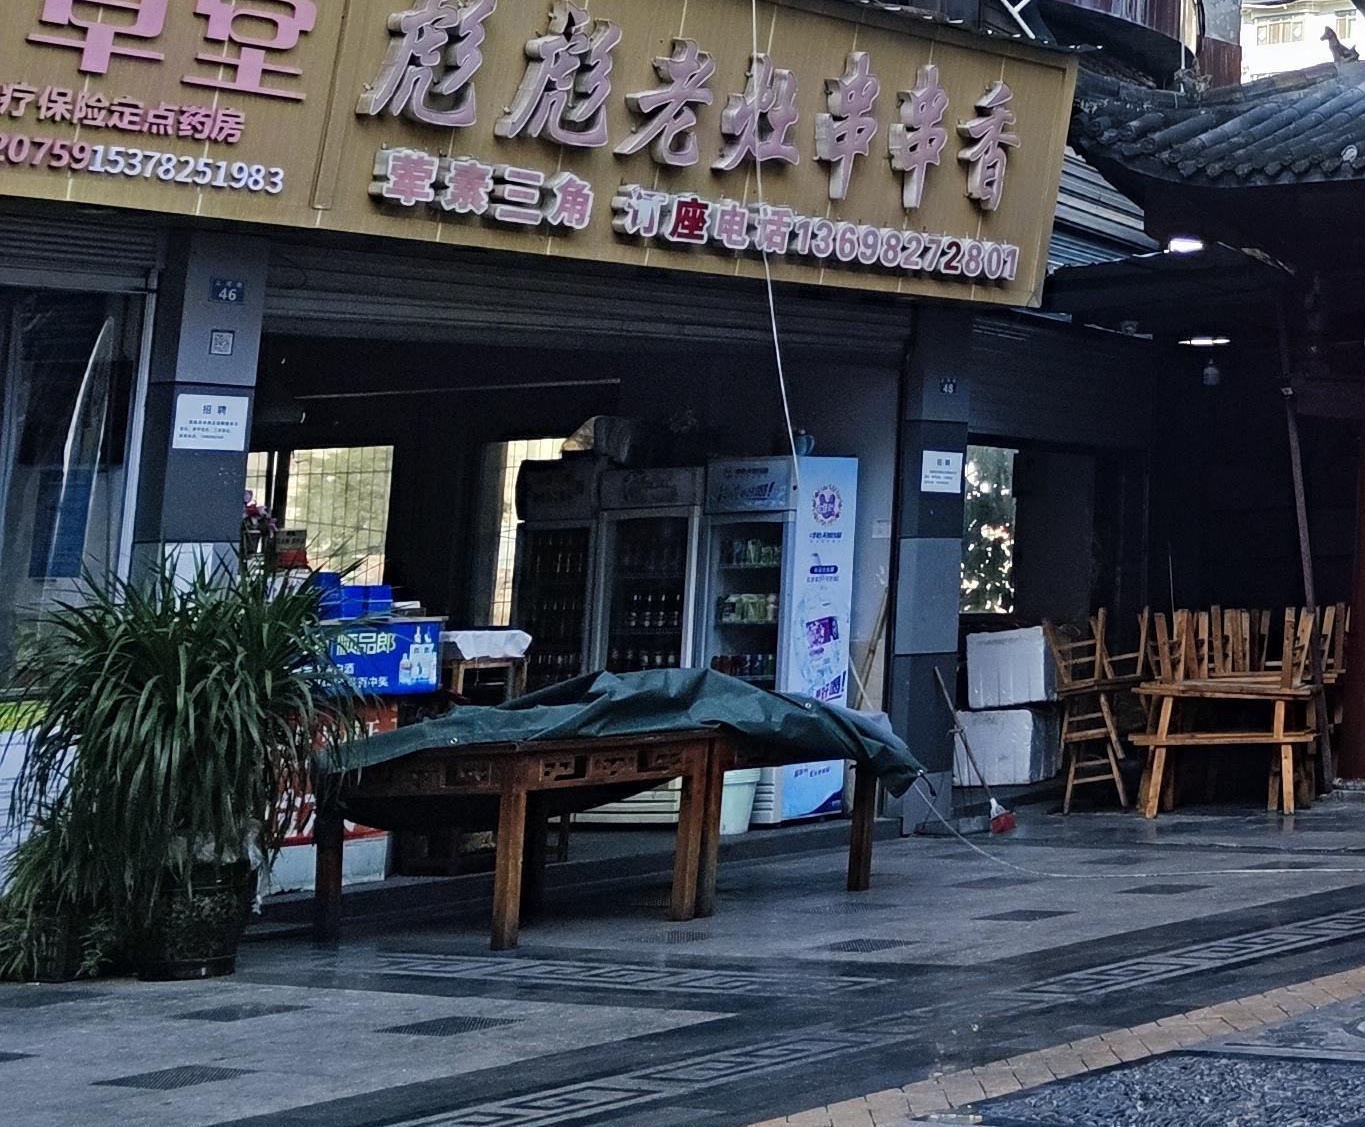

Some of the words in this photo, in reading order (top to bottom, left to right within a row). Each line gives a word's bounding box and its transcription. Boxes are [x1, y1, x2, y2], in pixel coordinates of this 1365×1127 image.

[0, 82, 245, 144] 疗保险定点药房
[218, 287, 237, 301] 46
